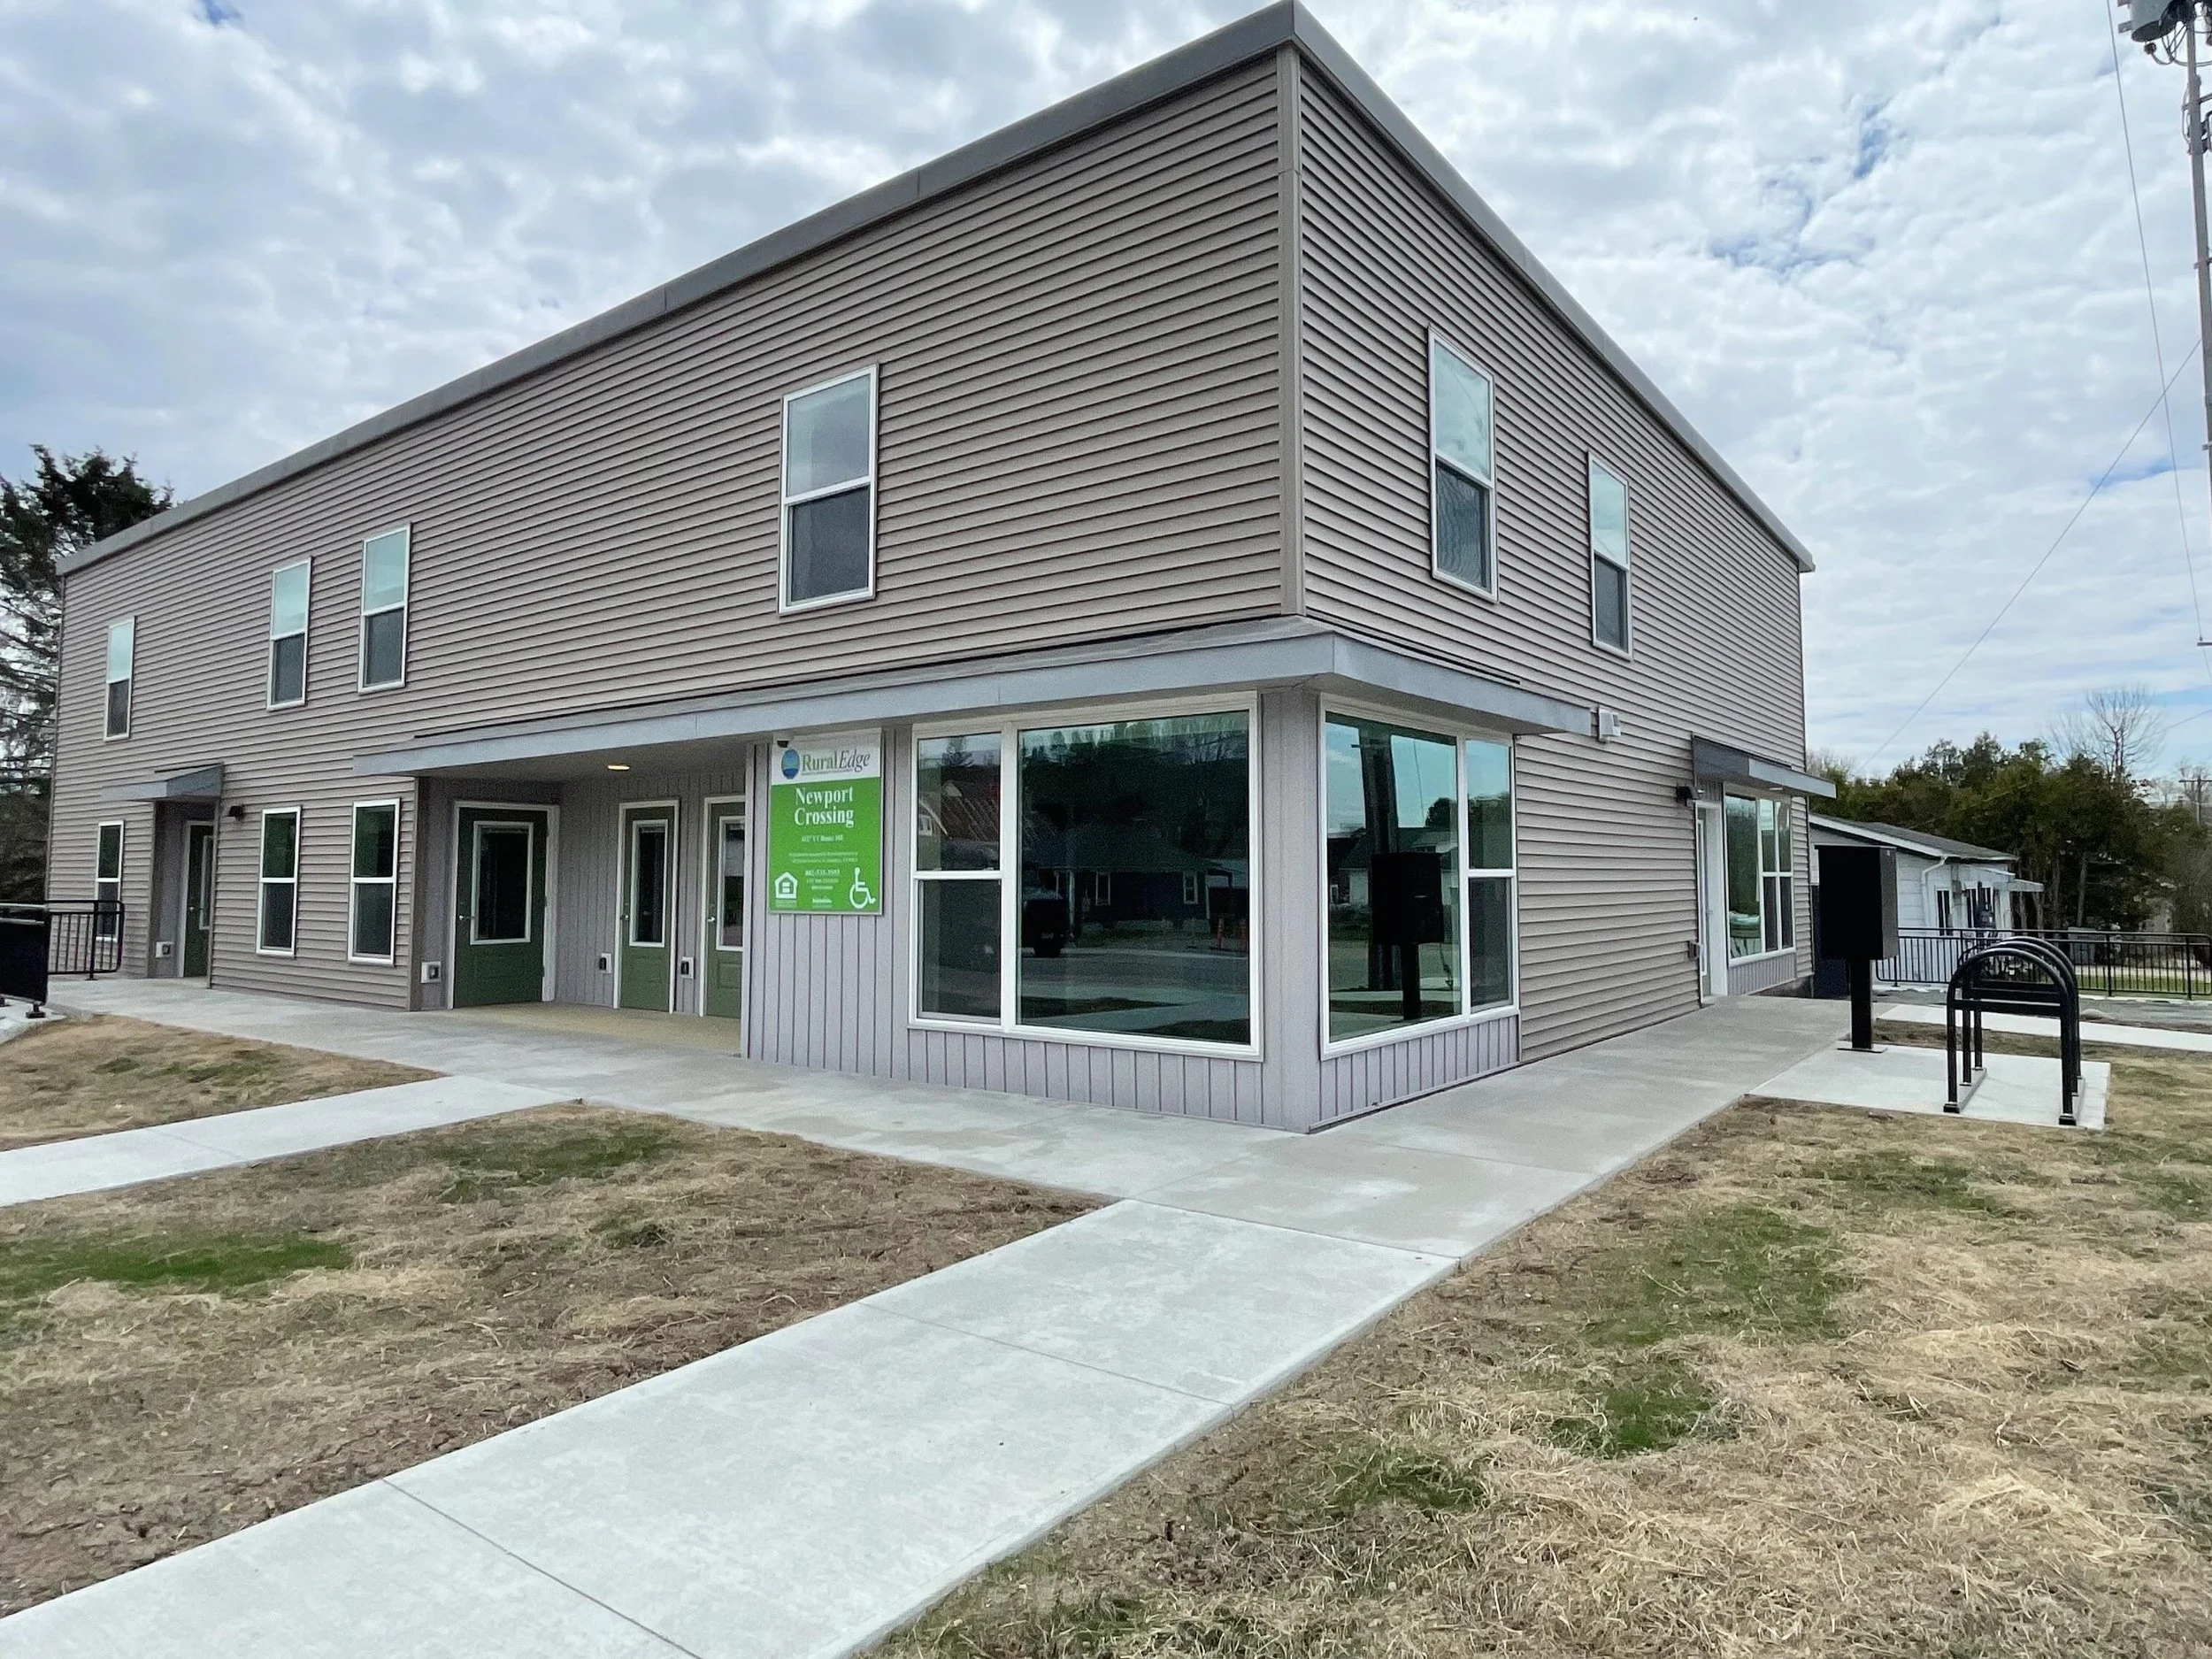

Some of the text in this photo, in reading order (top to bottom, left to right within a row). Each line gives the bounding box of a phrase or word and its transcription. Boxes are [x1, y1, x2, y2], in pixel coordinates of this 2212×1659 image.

[802, 748, 871, 772] RuralEdge
[795, 786, 854, 809] Newport
[794, 805, 854, 828] Crossing
